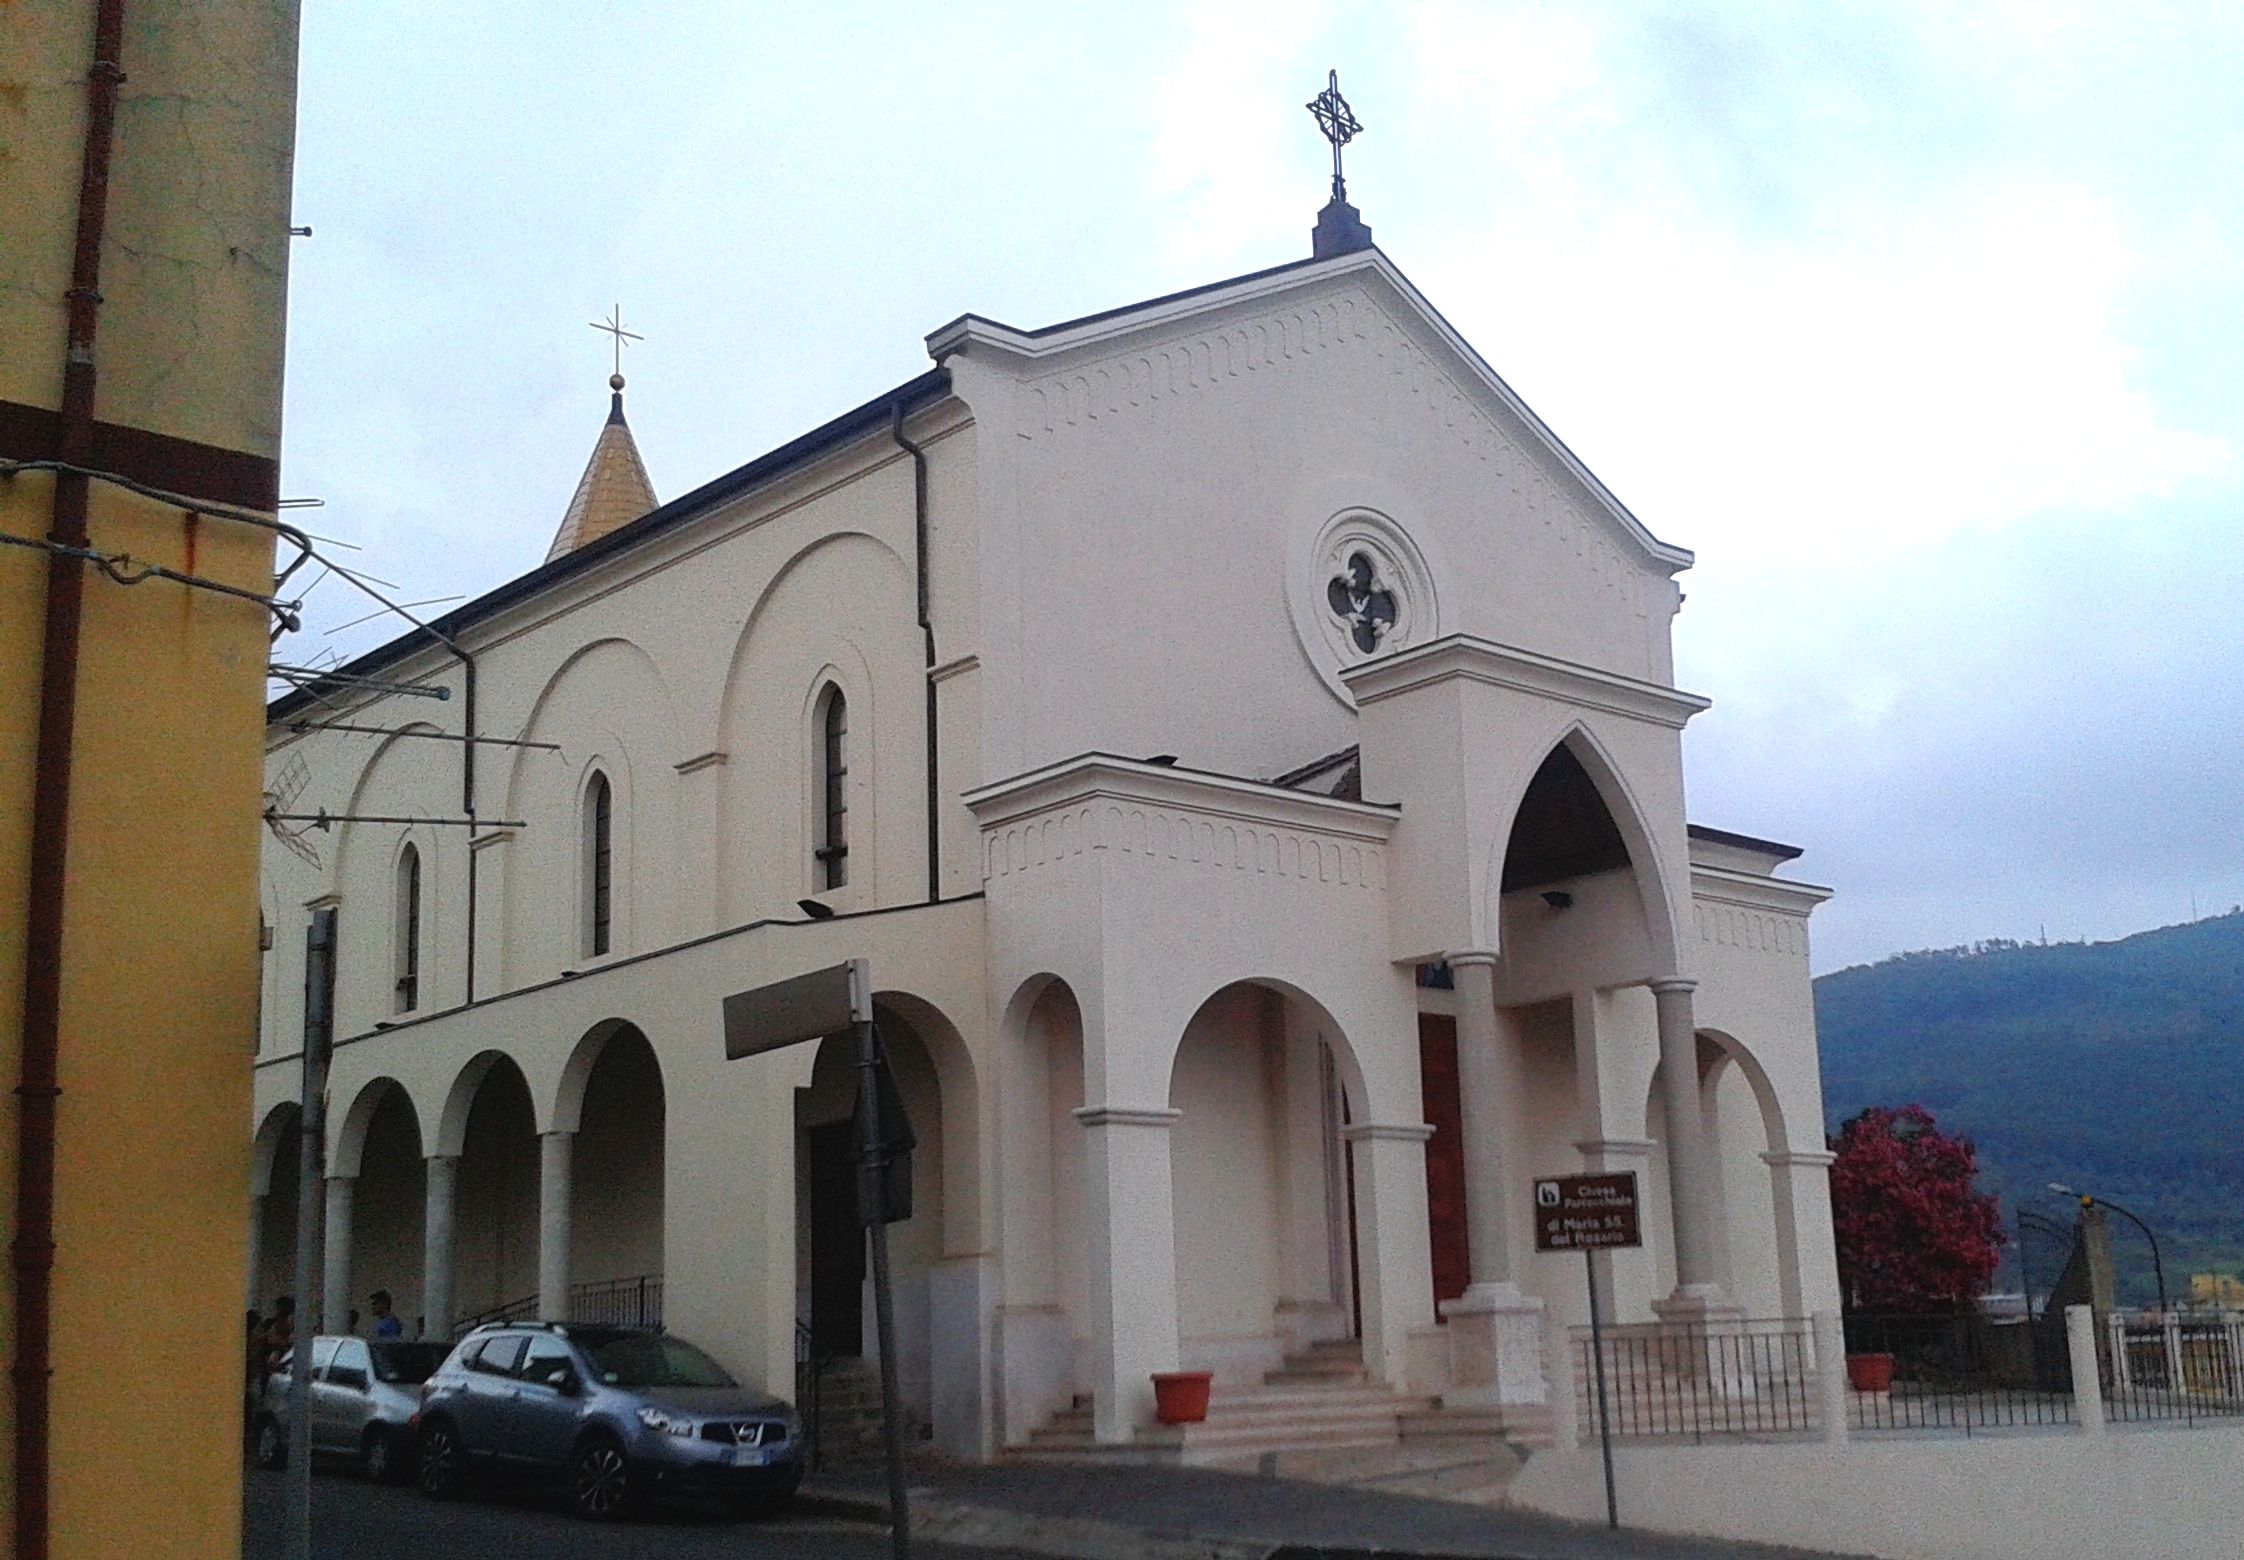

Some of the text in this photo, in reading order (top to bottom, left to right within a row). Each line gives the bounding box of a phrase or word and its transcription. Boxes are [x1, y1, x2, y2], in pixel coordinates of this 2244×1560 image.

[1563, 1216, 1601, 1231] Maria
[1550, 1230, 1625, 1246] del Rosario
